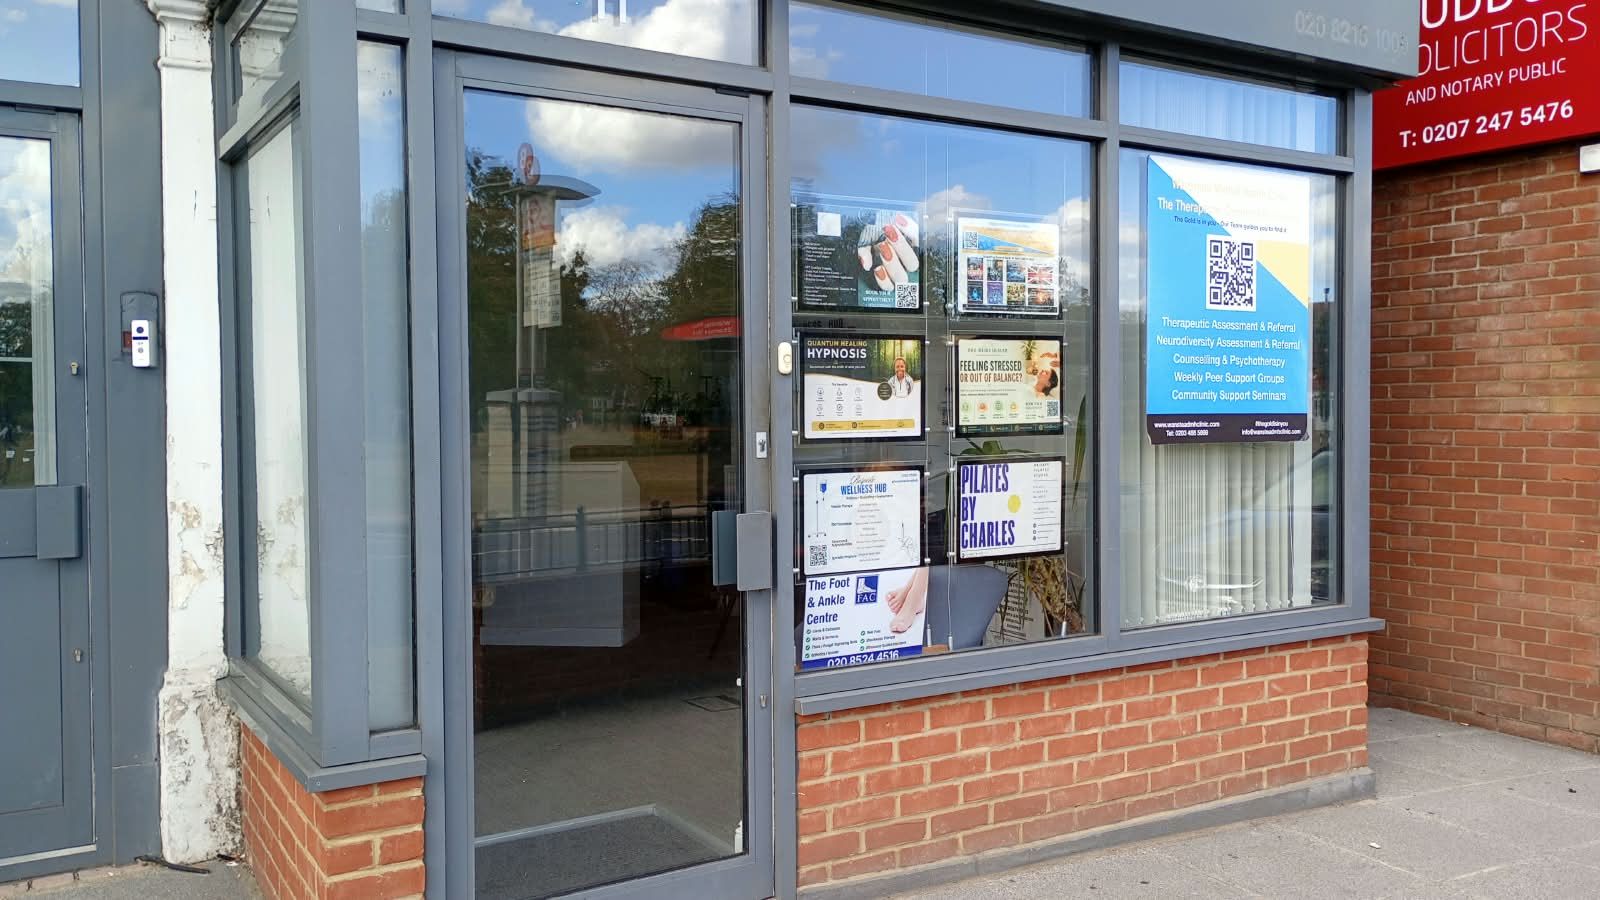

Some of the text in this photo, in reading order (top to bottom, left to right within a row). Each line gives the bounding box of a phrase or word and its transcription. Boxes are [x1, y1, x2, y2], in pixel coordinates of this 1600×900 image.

[1296, 10, 1326, 38] 020
[1405, 57, 1566, 106] AND NOTARY PUBLIC
[1400, 100, 1573, 148] T: 0207 247 5476
[1158, 197, 1173, 210] The
[1162, 317, 1296, 332] Therapeutic Assessment & Referral
[1157, 335, 1301, 350] Neurodiversity Assessment & Referral
[807, 348, 867, 359] HYPNOSIS
[960, 360, 1022, 372] FEELING STRESSED
[1173, 354, 1285, 368] Counselling & Psychotherapy
[960, 372, 1023, 383] OR OUT OF BALANCE?
[1174, 371, 1285, 385] Weekly Peer Support Groups
[1172, 389, 1287, 402] Community Support Seminars
[961, 464, 1009, 495] PILATES
[840, 483, 887, 495] WELLNESS HUB
[961, 496, 976, 522] BY
[961, 520, 1015, 549] CHARLES
[808, 577, 850, 591] The Foot
[807, 594, 845, 608] & Ankle
[857, 593, 876, 603] FAC
[806, 612, 838, 625] Centre
[827, 650, 899, 667] 020 8524 4516
